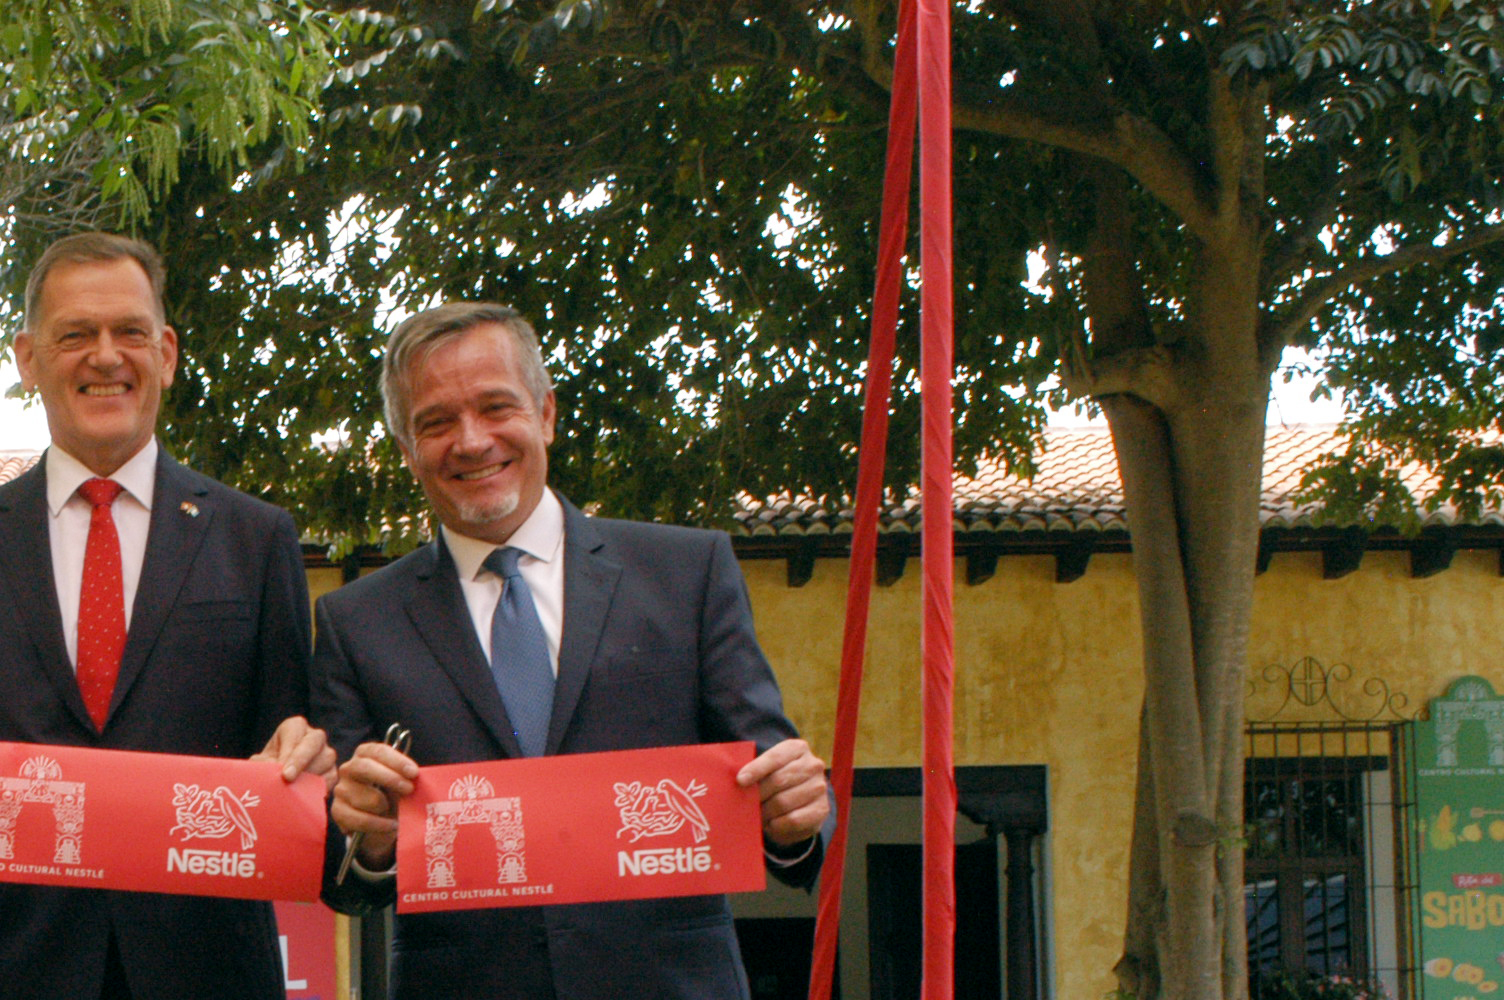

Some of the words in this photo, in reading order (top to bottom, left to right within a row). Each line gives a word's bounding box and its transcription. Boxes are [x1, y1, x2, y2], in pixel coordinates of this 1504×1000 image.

[8, 863, 62, 875] CULTURAL
[65, 868, 104, 879] NESTLÉ
[167, 847, 256, 878] Nestlé
[618, 845, 711, 877] Nestlé
[403, 891, 448, 903] CENTRO
[452, 887, 508, 899] CULTURAL
[512, 884, 554, 896] NESTLÉ
